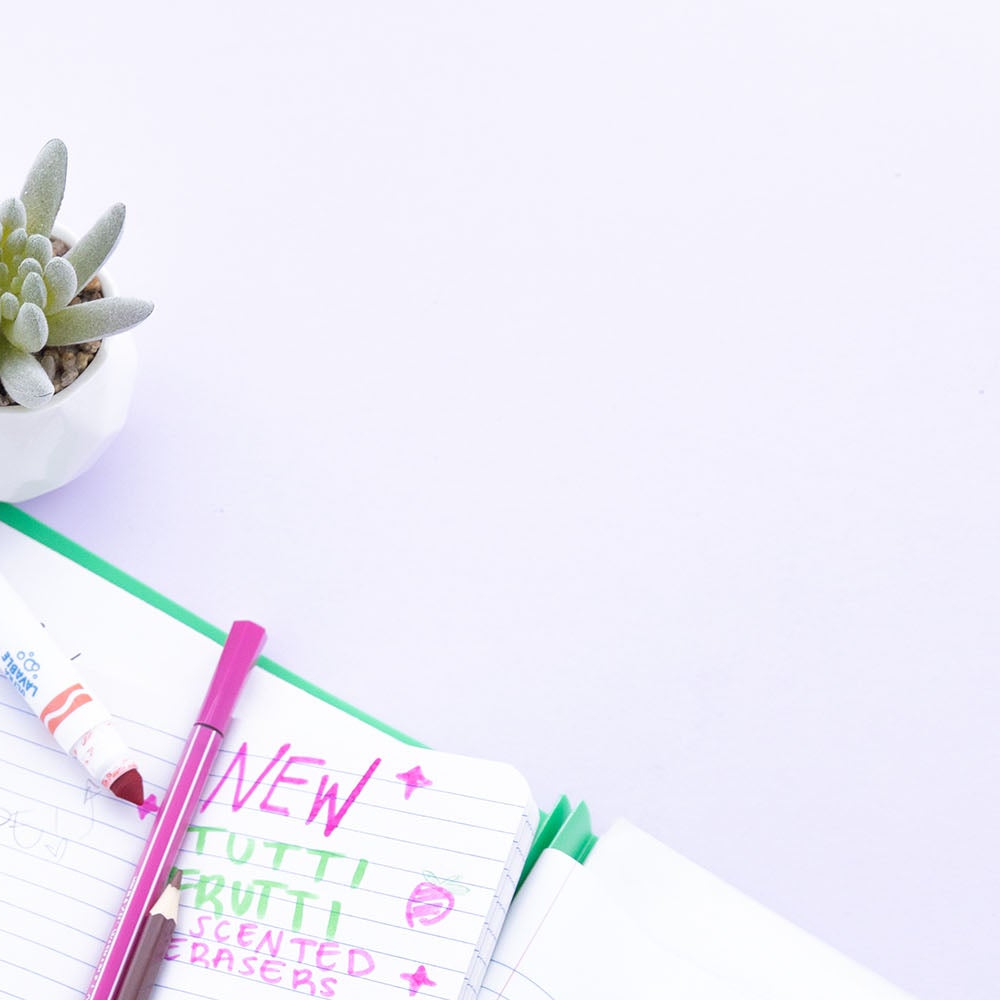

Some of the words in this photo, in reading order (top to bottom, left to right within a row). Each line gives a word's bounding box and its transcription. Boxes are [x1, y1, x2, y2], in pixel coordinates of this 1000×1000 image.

[1, 651, 39, 698] LAVABLE
[199, 742, 382, 837] NEW
[187, 826, 369, 889] TUTTI
[164, 937, 338, 997] ERASERS
[189, 915, 376, 977] SCENTED
